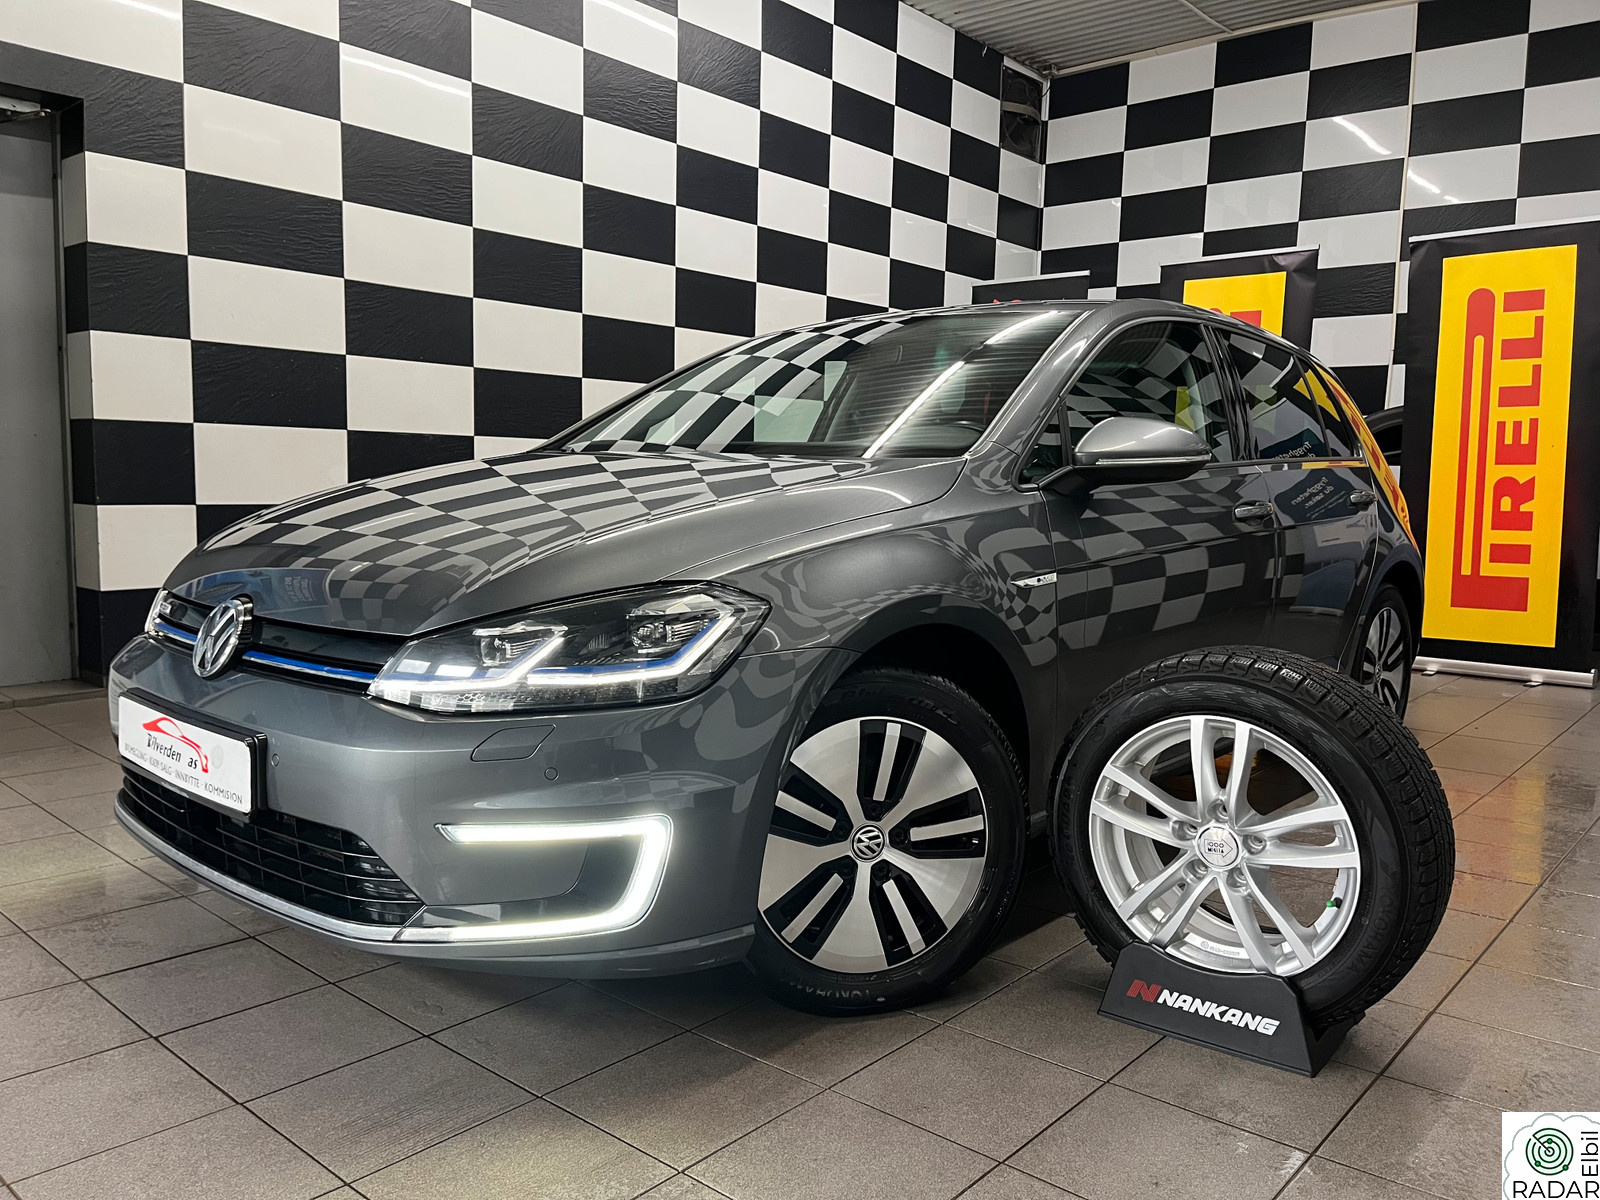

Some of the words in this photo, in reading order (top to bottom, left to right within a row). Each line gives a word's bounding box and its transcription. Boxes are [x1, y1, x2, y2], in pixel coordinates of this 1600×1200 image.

[1450, 287, 1546, 612] PIRELLI
[187, 757, 199, 770] as
[204, 783, 243, 805] KOMMISION
[1156, 989, 1281, 1036] NANKANG
